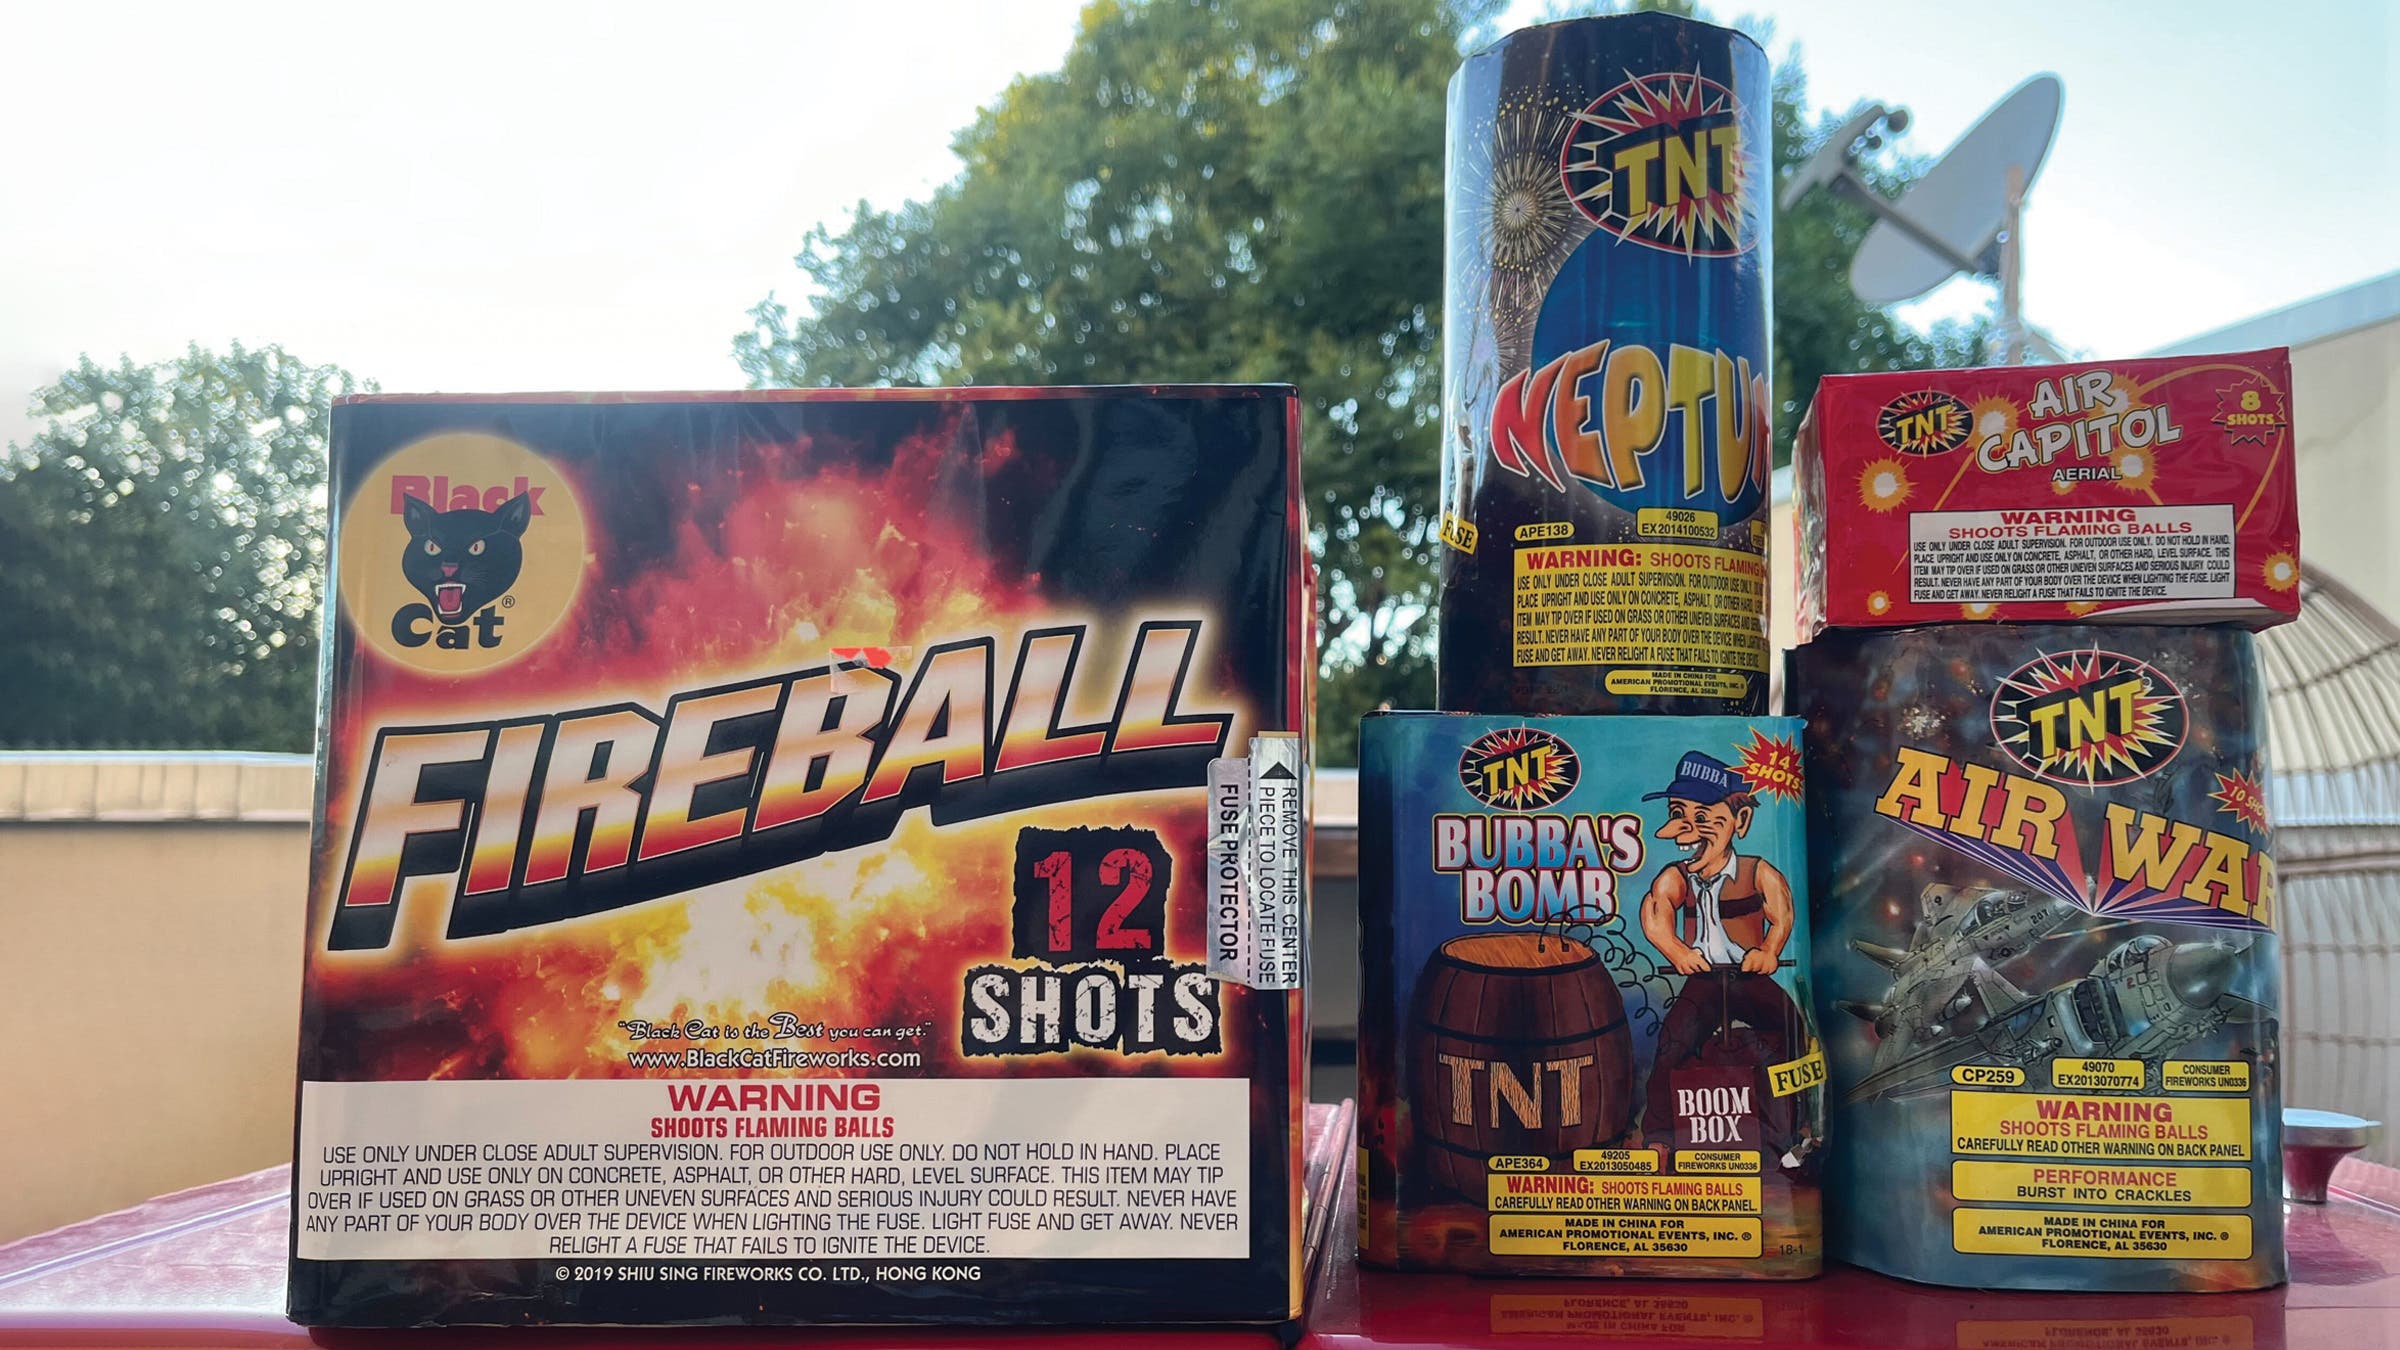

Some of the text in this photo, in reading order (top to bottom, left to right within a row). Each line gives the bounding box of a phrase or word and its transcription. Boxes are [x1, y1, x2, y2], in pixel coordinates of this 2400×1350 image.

[1614, 124, 1741, 218] TNT
[2029, 369, 2115, 420] AIR
[2241, 390, 2261, 411] 8
[1897, 405, 1953, 444] TNT
[2227, 413, 2275, 425] SHOTS
[1976, 406, 2183, 472] CAPITOL
[2052, 465, 2123, 482] AERIAL
[390, 475, 546, 516] Black
[1666, 511, 1696, 523] 49026
[2000, 508, 2136, 523] WARNING
[1519, 524, 1569, 539] APE138
[1641, 523, 1716, 538] EX2014100532
[1949, 522, 2193, 539] SHOOTS FLAMING BALLS
[1527, 549, 1762, 575] WARNING: SHOOTS FLAMING
[2029, 679, 2144, 760] TNT
[1483, 743, 1553, 795] TNT
[1769, 751, 1790, 770] 14
[1680, 761, 1728, 788] BUBBA
[1747, 762, 1801, 790] SHOTS
[328, 621, 1234, 950] FIREBALL
[1874, 747, 2068, 860] AIR
[2230, 785, 2266, 820] 10 SHO
[1436, 817, 1642, 871] BUBBA'S
[1219, 784, 1238, 961] FUSE PROTECTOR
[1259, 787, 1275, 983] PIECE TO LOCATE FUSE
[1282, 787, 1297, 983] REMOVE THIS CENTER
[1034, 848, 1152, 952] 12
[1461, 870, 1617, 925] BOMB
[970, 972, 1214, 1044] SHOTS
[684, 1020, 718, 1039] Cat
[725, 1025, 738, 1038] is
[744, 1023, 769, 1039] the
[768, 1012, 824, 1040] Best
[829, 1025, 858, 1041] you
[863, 1027, 891, 1038] can
[629, 1048, 921, 1069] www.BlackCatFireworks.com
[2082, 1060, 2115, 1073] 49070
[1774, 1060, 1823, 1092] FUSE
[1961, 1068, 2015, 1084] CP259
[2183, 1064, 2231, 1076] CONSUMER
[1439, 1053, 1594, 1129] TNT
[2058, 1074, 2140, 1088] EX2013070774
[2165, 1076, 2247, 1088] FIREWORKS UN0336
[667, 1084, 881, 1111] WARNING
[1677, 1086, 1752, 1116] BOOM
[2036, 1099, 2173, 1123] WARNING
[651, 1116, 894, 1138] SHOOTS FLAMING BALLS
[1689, 1115, 1743, 1144] BOX
[2000, 1120, 2208, 1140] SHOOTS FLAMING BALLS
[323, 1142, 1220, 1164] USE ONLY UNDER CLOSE ADULT SUPERVISION. FOR OUTDOOR USE ONLY. DO NOT HOLD IN HAND. PLACE
[1601, 1150, 1631, 1161] 49205
[1694, 1152, 1741, 1162] CONSUMER
[1957, 1136, 2244, 1157] CAREFULLY READ OTHER WARNING ON BACK PANEL
[1494, 1156, 1544, 1170] APE364
[1579, 1160, 1652, 1172] EX2013050485
[1678, 1162, 1758, 1171] FIREWORKS UN0336
[1506, 1176, 1743, 1196] WARNING: SHOOTS FLAMING BALLS
[2033, 1168, 2177, 1187] PERFORMANCE
[1494, 1197, 1757, 1211] CAREFULLY READ OTHER WARNING ON BACK PANEL.
[2017, 1185, 2191, 1202] BURST INTO CRACKLES
[1565, 1218, 1684, 1228] MADE IN CHINA FOR
[2044, 1216, 2165, 1229] MADE IN CHINA FOR
[1499, 1228, 1562, 1238] AMERICAN
[1566, 1229, 1654, 1239] PROMOTIONAL
[1658, 1230, 1709, 1241] EVENTS,
[1713, 1231, 1737, 1241] INC.
[1978, 1225, 2042, 1236] AMERICAN
[2045, 1227, 2135, 1239] PROMOTIONAL
[2139, 1230, 2189, 1242] EVENTS,
[2193, 1231, 2216, 1240] INC.
[1563, 1241, 1687, 1252] FLORENCE, AL 35630
[2042, 1238, 2167, 1251] FLORENCE, AL 35630
[574, 1266, 613, 1280] 2019
[618, 1266, 654, 1280] SHIU
[659, 1266, 697, 1280] SING
[703, 1266, 792, 1281] FIREWORKS
[798, 1266, 826, 1281] CO.
[832, 1266, 869, 1283] LTD.,
[876, 1266, 926, 1280] HONG
[932, 1266, 980, 1280] KONG
